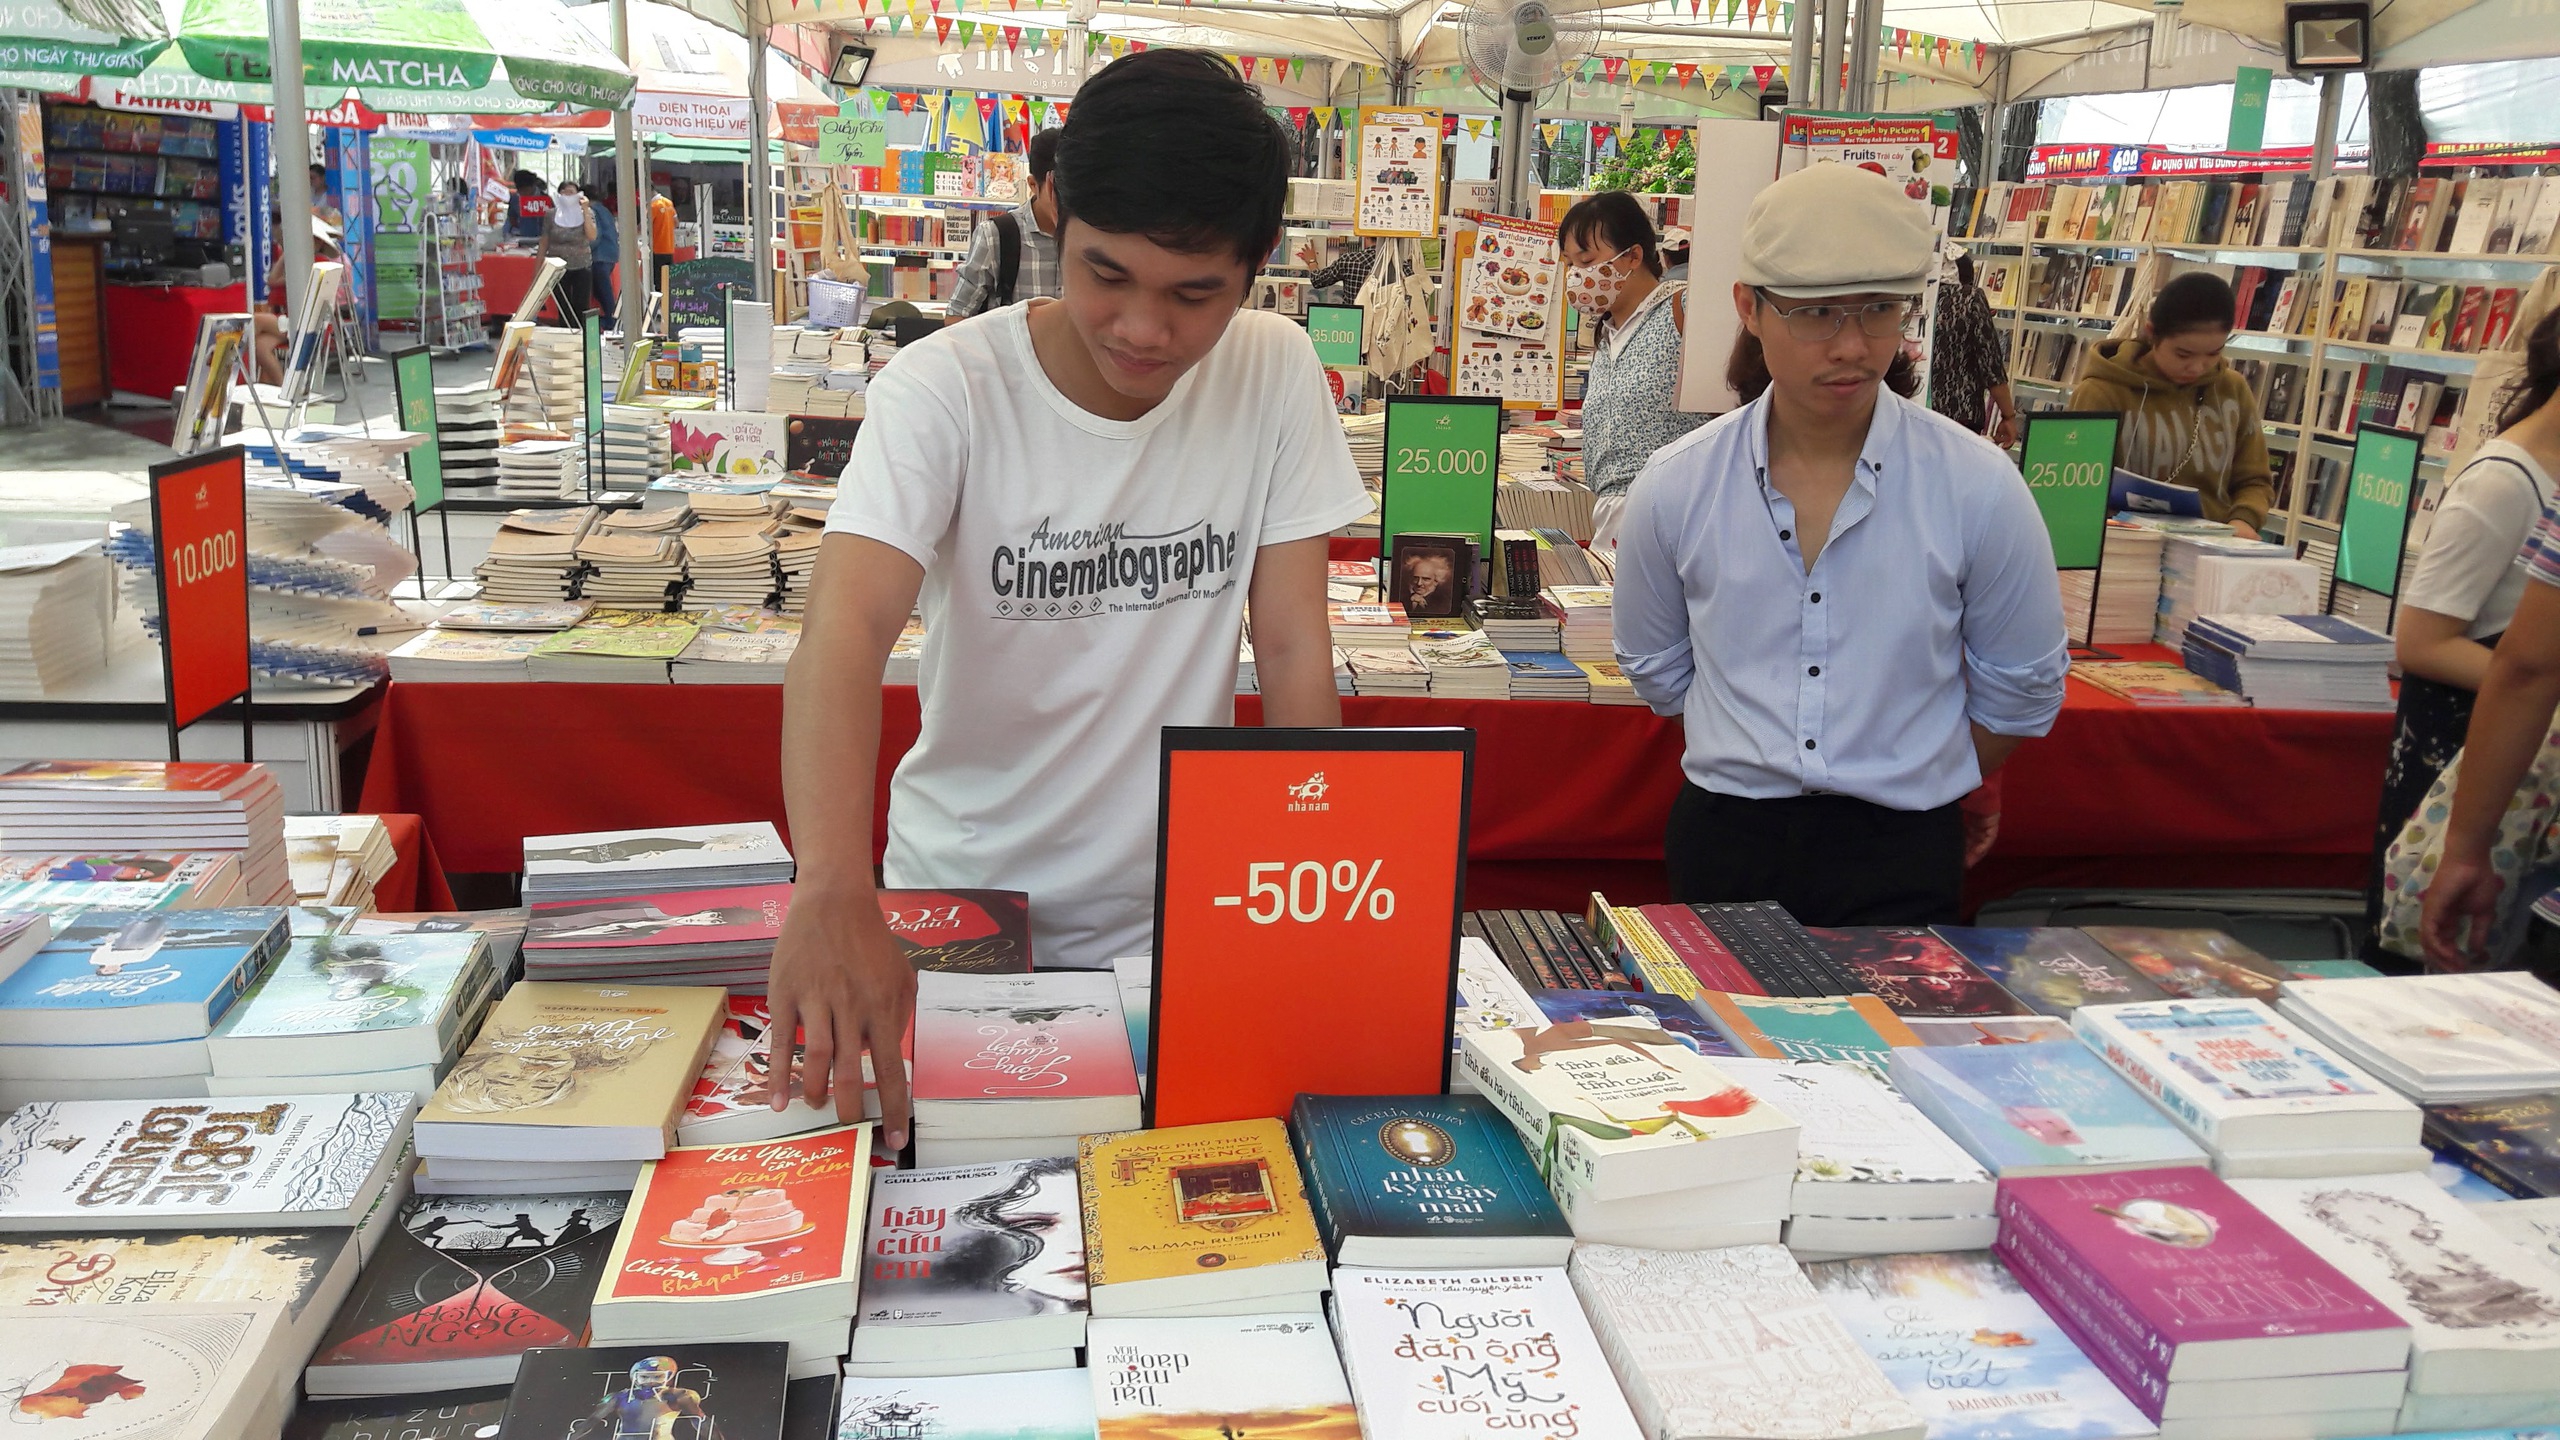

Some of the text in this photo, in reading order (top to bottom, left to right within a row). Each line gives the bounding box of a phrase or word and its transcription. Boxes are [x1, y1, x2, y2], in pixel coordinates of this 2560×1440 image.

[332, 57, 469, 88] MATCHA
[542, 80, 564, 93] CHO
[659, 102, 731, 117] ĐIỆN THOẠI
[638, 114, 692, 128] THƯƠNG
[695, 117, 725, 130] HIỆU
[1813, 126, 1921, 137] Learning English by Pictures
[494, 133, 545, 147] vinaphone
[1920, 125, 1931, 142] 1
[1843, 149, 1876, 161] Fruits
[1937, 136, 1948, 154] 2
[1471, 186, 1495, 196] KID'S
[1498, 231, 1546, 246] Birthday Party
[1311, 328, 1355, 344] 35.000
[1396, 448, 1487, 475] 25.000
[2029, 462, 2105, 488] 25.000
[2356, 471, 2404, 508] 15.000
[1028, 516, 1160, 552] American
[172, 529, 237, 588] 10.000
[991, 523, 1239, 600] Cinematographe
[1108, 603, 1124, 613] The
[1213, 858, 1396, 925] -50%
[1567, 1070, 1607, 1081] hay
[1350, 1107, 1409, 1127] CECELIA
[884, 1170, 998, 1185] GUILLAUME MUSSO
[1387, 1166, 1469, 1183] nhật
[1423, 1184, 1500, 1202] ngày
[1416, 1200, 1485, 1214] mai
[881, 1206, 947, 1233] hãy
[876, 1232, 943, 1256] cứu
[1128, 1238, 1206, 1252] SALMAN
[624, 1258, 701, 1282] Chetan
[873, 1259, 931, 1280] em
[132, 1269, 180, 1304] Eliza
[1363, 1275, 1544, 1286] ELIZABETH GILBERT
[2153, 1277, 2354, 1319] MIRANDA
[1397, 1299, 1535, 1338] Người
[1394, 1332, 1561, 1373] đàn ông
[1141, 1352, 1189, 1374] dao
[1109, 1366, 1170, 1386] mạc
[1441, 1363, 1566, 1403] Mỹ
[1417, 1391, 1491, 1415] cuối
[1485, 1409, 1579, 1438] cùng
